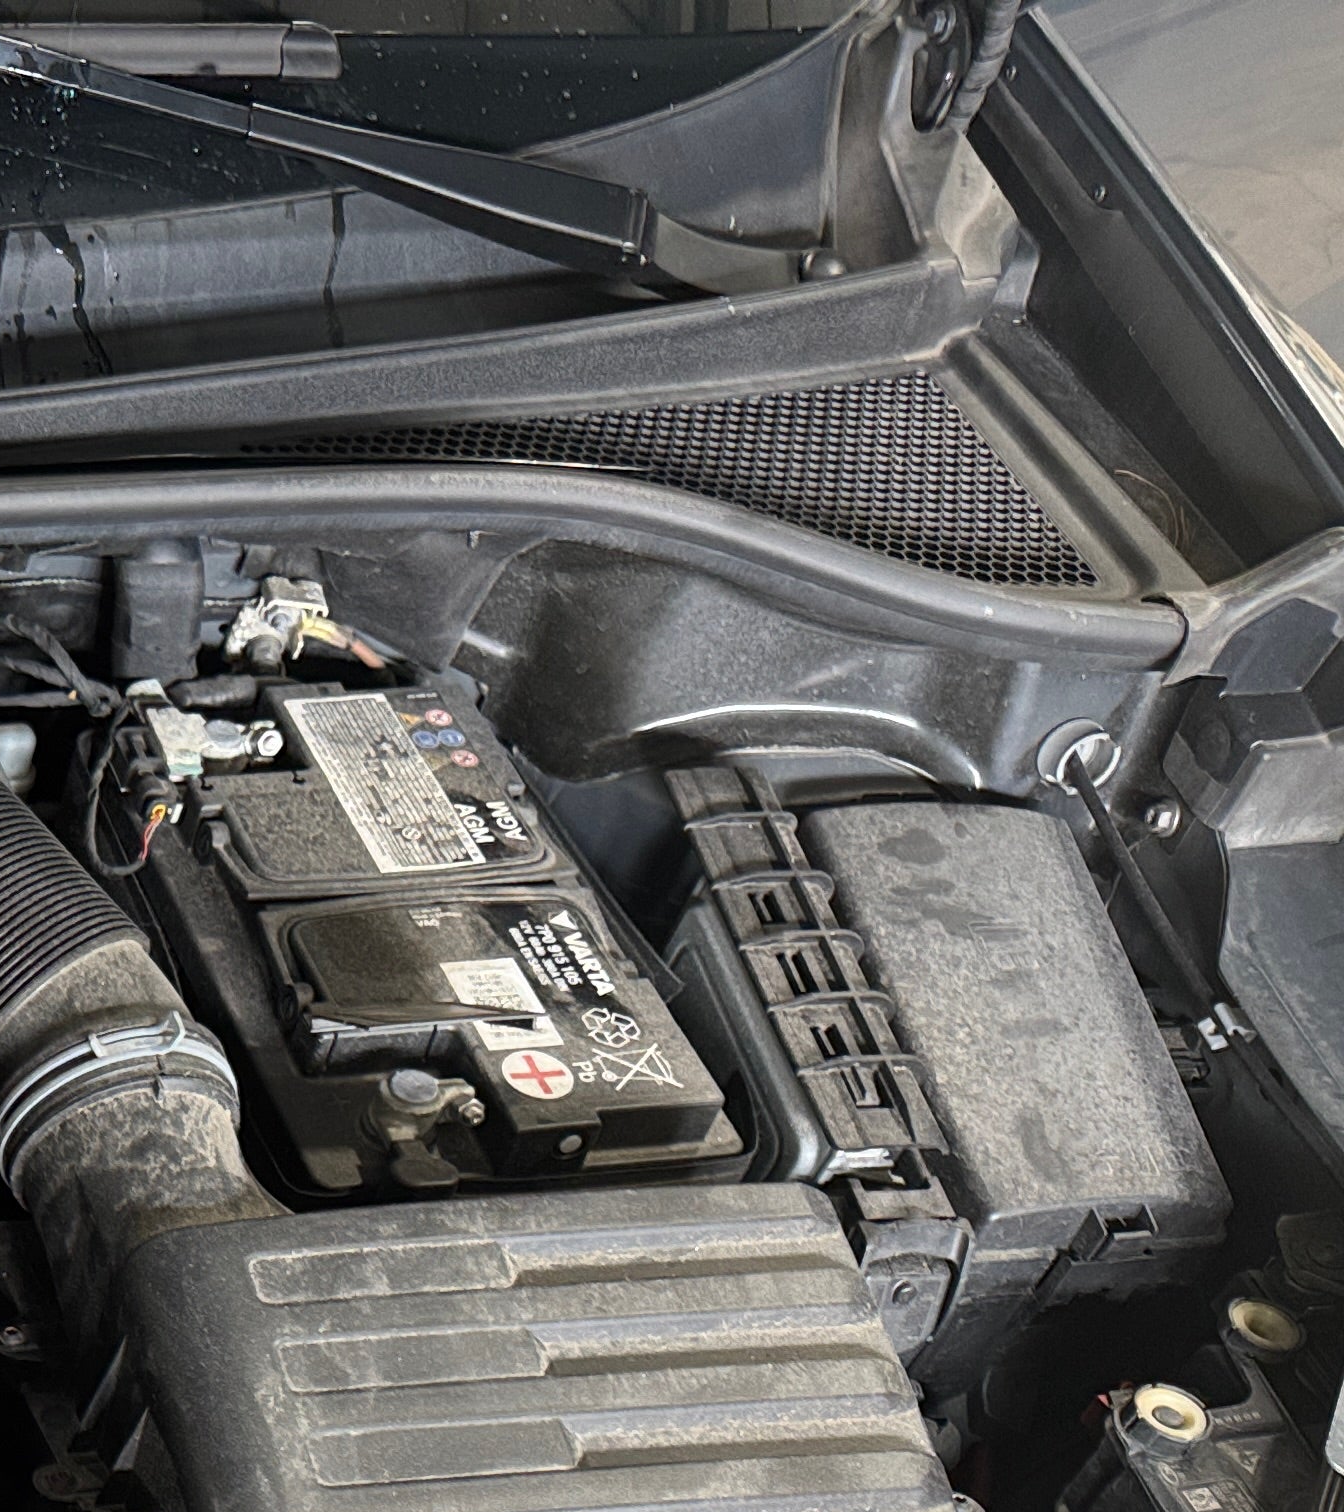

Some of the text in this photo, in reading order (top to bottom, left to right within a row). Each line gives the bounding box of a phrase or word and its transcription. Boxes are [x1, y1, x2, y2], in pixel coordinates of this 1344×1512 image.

[454, 803, 495, 844] AGM
[486, 801, 528, 841] AGM
[547, 944, 570, 965] 915
[563, 931, 615, 997] VARTA
[571, 1060, 595, 1083] Pb
